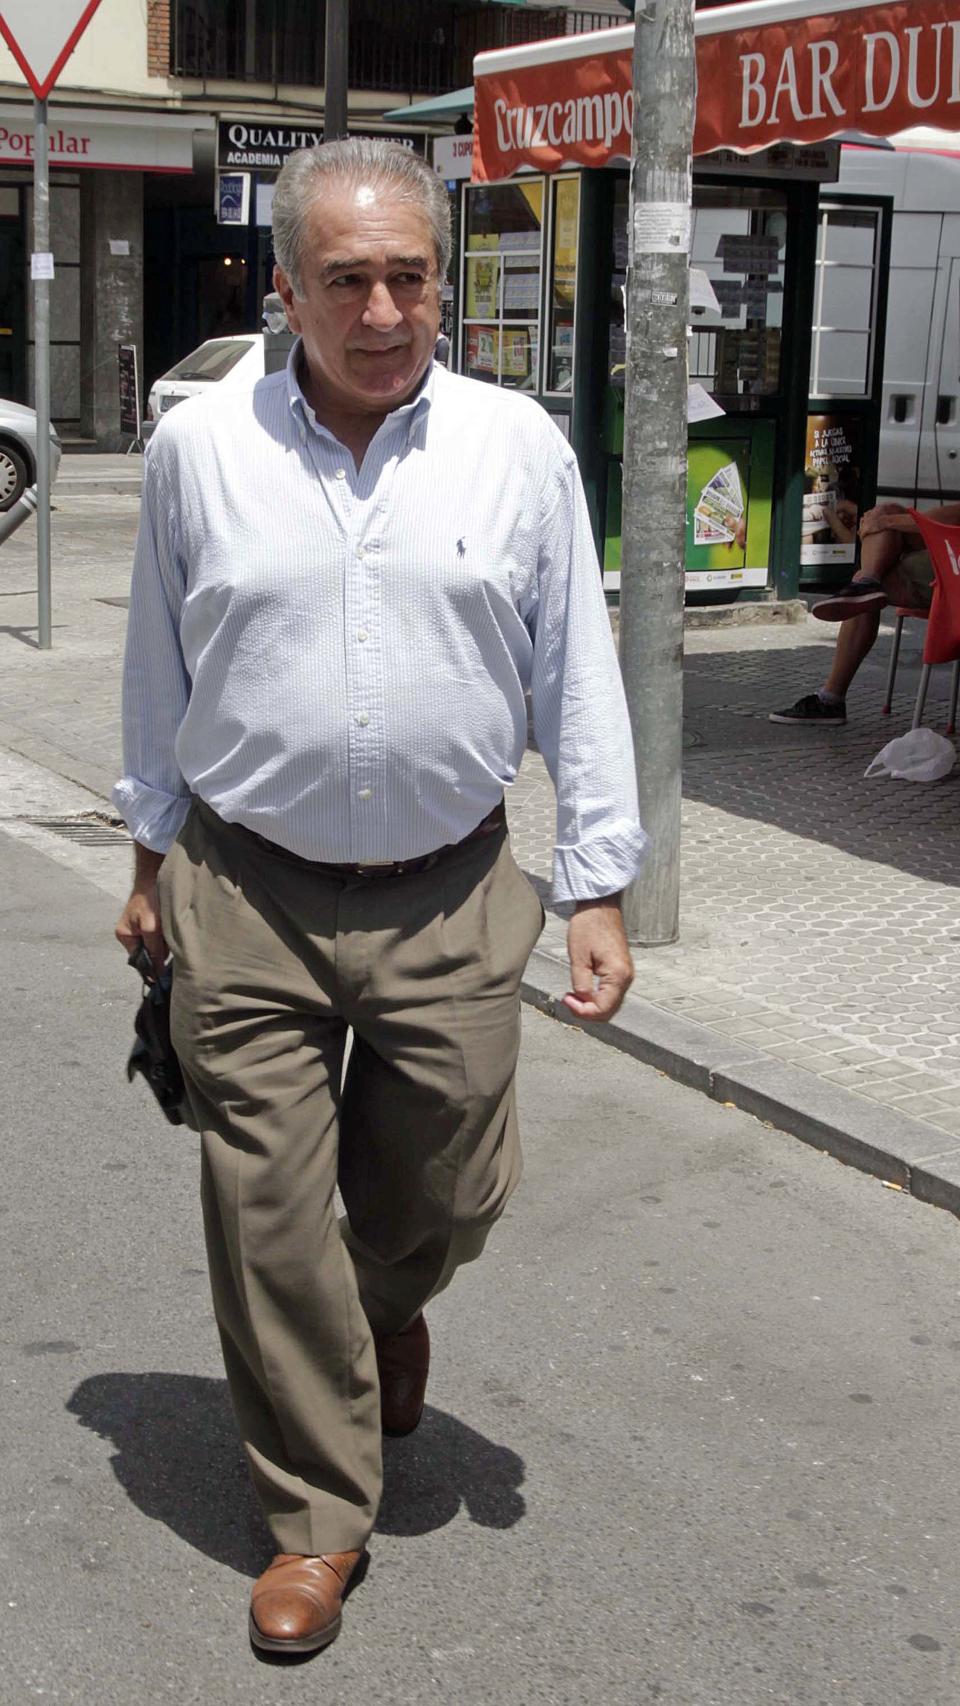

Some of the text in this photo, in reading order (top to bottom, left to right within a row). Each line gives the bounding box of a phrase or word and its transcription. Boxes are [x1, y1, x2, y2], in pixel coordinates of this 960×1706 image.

[738, 39, 846, 128] BAR
[228, 124, 324, 149] QUALITY
[494, 89, 634, 152] Cruzcampo
[227, 151, 281, 166] ACADEMIA
